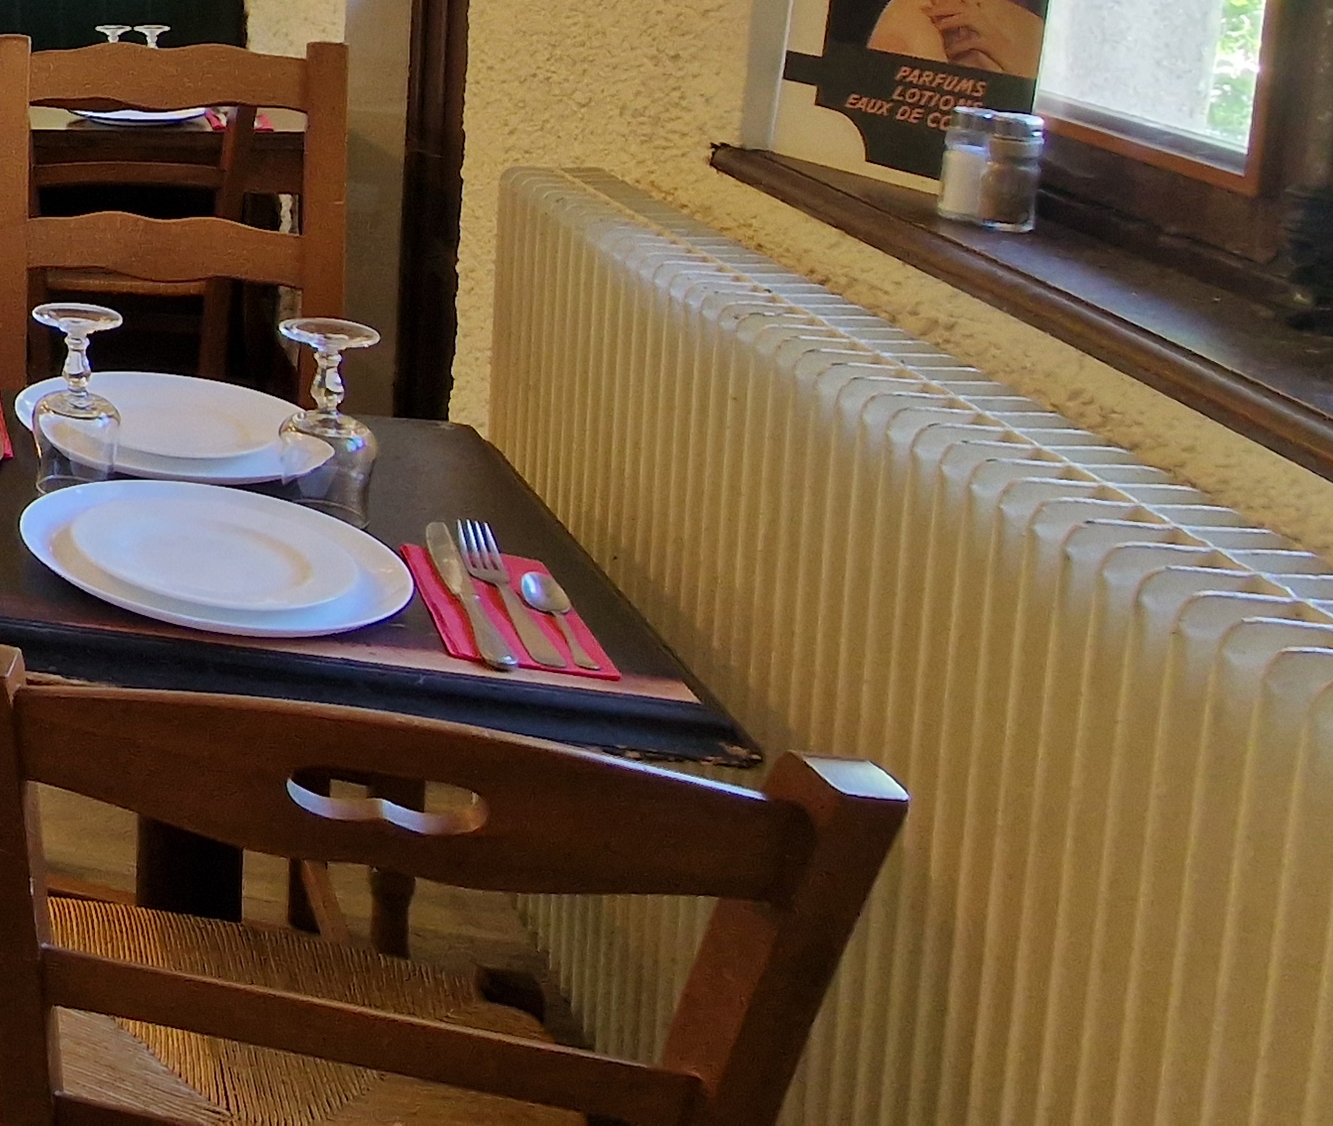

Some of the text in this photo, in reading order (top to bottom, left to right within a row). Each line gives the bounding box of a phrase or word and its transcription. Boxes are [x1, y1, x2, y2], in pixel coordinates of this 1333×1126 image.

[895, 66, 988, 97] PARFUMS
[845, 93, 894, 116] EAUX
[896, 106, 924, 123] DE
